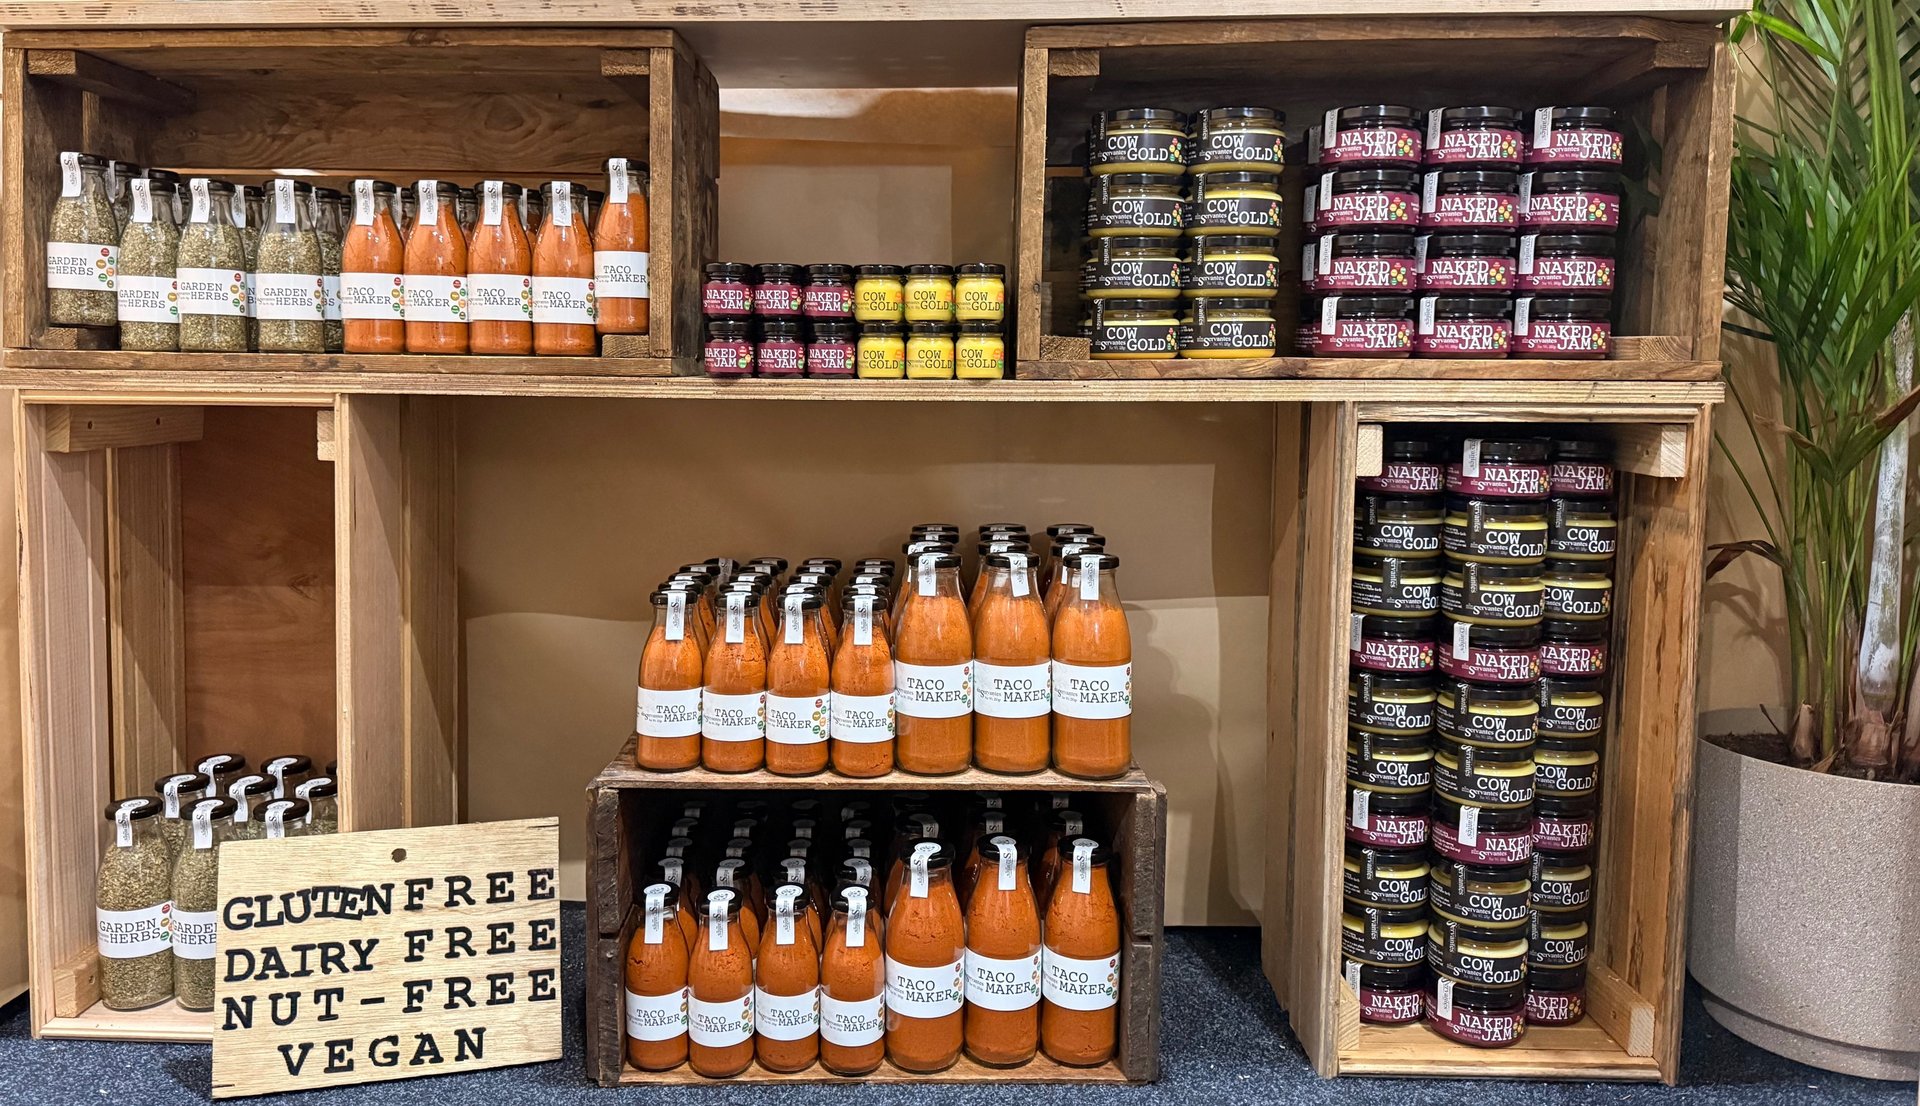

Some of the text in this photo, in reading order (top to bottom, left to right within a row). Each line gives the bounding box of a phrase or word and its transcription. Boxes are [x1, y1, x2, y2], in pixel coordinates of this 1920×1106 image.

[1108, 136, 1138, 149] COW
[1212, 135, 1244, 149] COW
[1341, 132, 1397, 146] NAKED
[1444, 134, 1501, 147] NAKED
[1556, 133, 1612, 146] NAKED
[1127, 148, 1168, 161] GOLD
[1233, 148, 1273, 161] GOLD
[1362, 144, 1396, 157] JAM
[1466, 146, 1501, 158] JAM
[1579, 147, 1611, 160] JAM
[1112, 201, 1144, 213] COW
[1207, 200, 1239, 213] COW
[1334, 196, 1389, 209] NAKED
[1441, 198, 1498, 211] NAKED
[1531, 196, 1588, 209] NAKED
[1133, 212, 1172, 226] GOLD
[1228, 212, 1268, 224] GOLD
[1354, 208, 1388, 221] JAM
[1463, 210, 1497, 223] JAM
[1552, 208, 1587, 221] JAM
[48, 256, 87, 266] GARDEN
[56, 266, 94, 276] HERBS
[603, 265, 631, 274] TACO
[1111, 262, 1143, 275] COW
[1204, 262, 1236, 275] COW
[610, 274, 647, 283] MAKER
[1132, 274, 1170, 286] GOLD
[1225, 274, 1265, 286] GOLD
[180, 282, 222, 292] GARDEN
[263, 288, 308, 297] GARDEN
[347, 287, 375, 296] TACO
[477, 288, 505, 297] TACO
[119, 290, 159, 299] GARDEN
[190, 291, 228, 301] HERBS
[408, 289, 433, 298] TACO
[542, 291, 571, 300] TACO
[706, 289, 743, 300] NAKED
[755, 290, 789, 300] NAKED
[806, 291, 841, 301] NAKED
[863, 292, 886, 301] COW
[913, 290, 936, 300] COW
[965, 292, 988, 301] COW
[128, 299, 165, 308] HERBS
[276, 297, 312, 306] HERBS
[353, 295, 391, 305] MAKER
[413, 298, 450, 307] MAKER
[484, 296, 521, 306] MAKER
[549, 299, 586, 309] MAKER
[721, 300, 744, 309] JAM
[767, 300, 790, 309] JAM
[818, 301, 841, 311] JAM
[870, 301, 898, 311] GOLD
[920, 300, 949, 310] GOLD
[971, 301, 1000, 311] GOLD
[1107, 327, 1137, 340] COW
[1210, 324, 1243, 336] COW
[1342, 324, 1397, 337] NAKED
[1436, 325, 1493, 338] NAKED
[1534, 326, 1591, 338] NAKED
[1127, 339, 1165, 351] GOLD
[1232, 335, 1268, 347] GOLD
[1364, 336, 1397, 348] JAM
[1459, 338, 1492, 349] JAM
[1557, 338, 1591, 350] JAM
[705, 348, 737, 358] NAKED
[761, 348, 796, 359] NAKED
[809, 348, 844, 358] NAKED
[863, 350, 885, 359] COW
[918, 350, 941, 359] COW
[961, 349, 983, 358] COW
[714, 358, 737, 368] JAM
[775, 358, 796, 368] JAM
[822, 358, 845, 369] JAM
[869, 360, 898, 369] GOLD
[925, 359, 952, 369] GOLD
[968, 358, 997, 368] GOLD
[1485, 469, 1540, 482] NAKED
[1508, 481, 1539, 493] JAM
[1381, 526, 1414, 538] COW
[1486, 532, 1520, 544] COW
[1403, 537, 1438, 549] GOLD
[1509, 544, 1543, 556] GOLD
[1481, 593, 1515, 606] COW
[1504, 604, 1539, 617] GOLD
[1366, 642, 1419, 656] NAKED
[1387, 656, 1419, 668] JAM
[1475, 654, 1529, 668] NAKED
[1498, 666, 1529, 679] JAM
[907, 678, 944, 689] TACO
[994, 679, 1032, 691] TACO
[1070, 679, 1109, 691] TACO
[915, 690, 961, 702] MAKER
[1003, 690, 1047, 702] MAKER
[1080, 691, 1125, 703] MAKER
[656, 705, 685, 714] TACO
[715, 709, 743, 718] TACO
[771, 710, 796, 720] TACO
[845, 711, 874, 720] TACO
[664, 711, 698, 722] MAKER
[721, 716, 757, 727] MAKER
[1473, 716, 1507, 729] COW
[776, 720, 811, 729] MAKER
[853, 718, 887, 728] MAKER
[1495, 728, 1531, 741] GOLD
[1477, 778, 1510, 790] COW
[1500, 789, 1532, 802] GOLD
[1376, 820, 1424, 834] NAKED
[1398, 832, 1423, 845] JAM
[1486, 836, 1530, 851] NAKED
[1507, 849, 1530, 862] JAM
[223, 868, 555, 931] GLUTEN FREE
[1469, 895, 1503, 908] COW
[1492, 907, 1526, 920] GOLD
[100, 918, 156, 933] GARDEN
[172, 920, 217, 935] GARDE
[110, 928, 161, 944] HERBS
[224, 918, 556, 982] DAIRY FREE
[1461, 957, 1494, 970] COW
[977, 968, 1015, 983] TACO
[1052, 965, 1088, 983] TACO
[1483, 969, 1520, 983] GOLD
[897, 976, 935, 991] TACO
[986, 982, 1031, 995] MAKER
[1059, 982, 1106, 995] MAKER
[906, 989, 952, 1003] MAKER
[1372, 994, 1419, 1008] NAKED
[637, 1009, 665, 1018] TACO
[771, 1008, 799, 1018] TACO
[1393, 1006, 1419, 1019] JAM
[644, 1013, 680, 1026] MAKER
[698, 1014, 726, 1024] TACO
[777, 1013, 813, 1026] MAKER
[836, 1015, 865, 1024] TACO
[1460, 1013, 1513, 1029] NAKED
[705, 1021, 741, 1033] MAKER
[843, 1019, 878, 1032] MAKER
[1482, 1027, 1512, 1040] JAM
[277, 1027, 486, 1076] VEGAN
